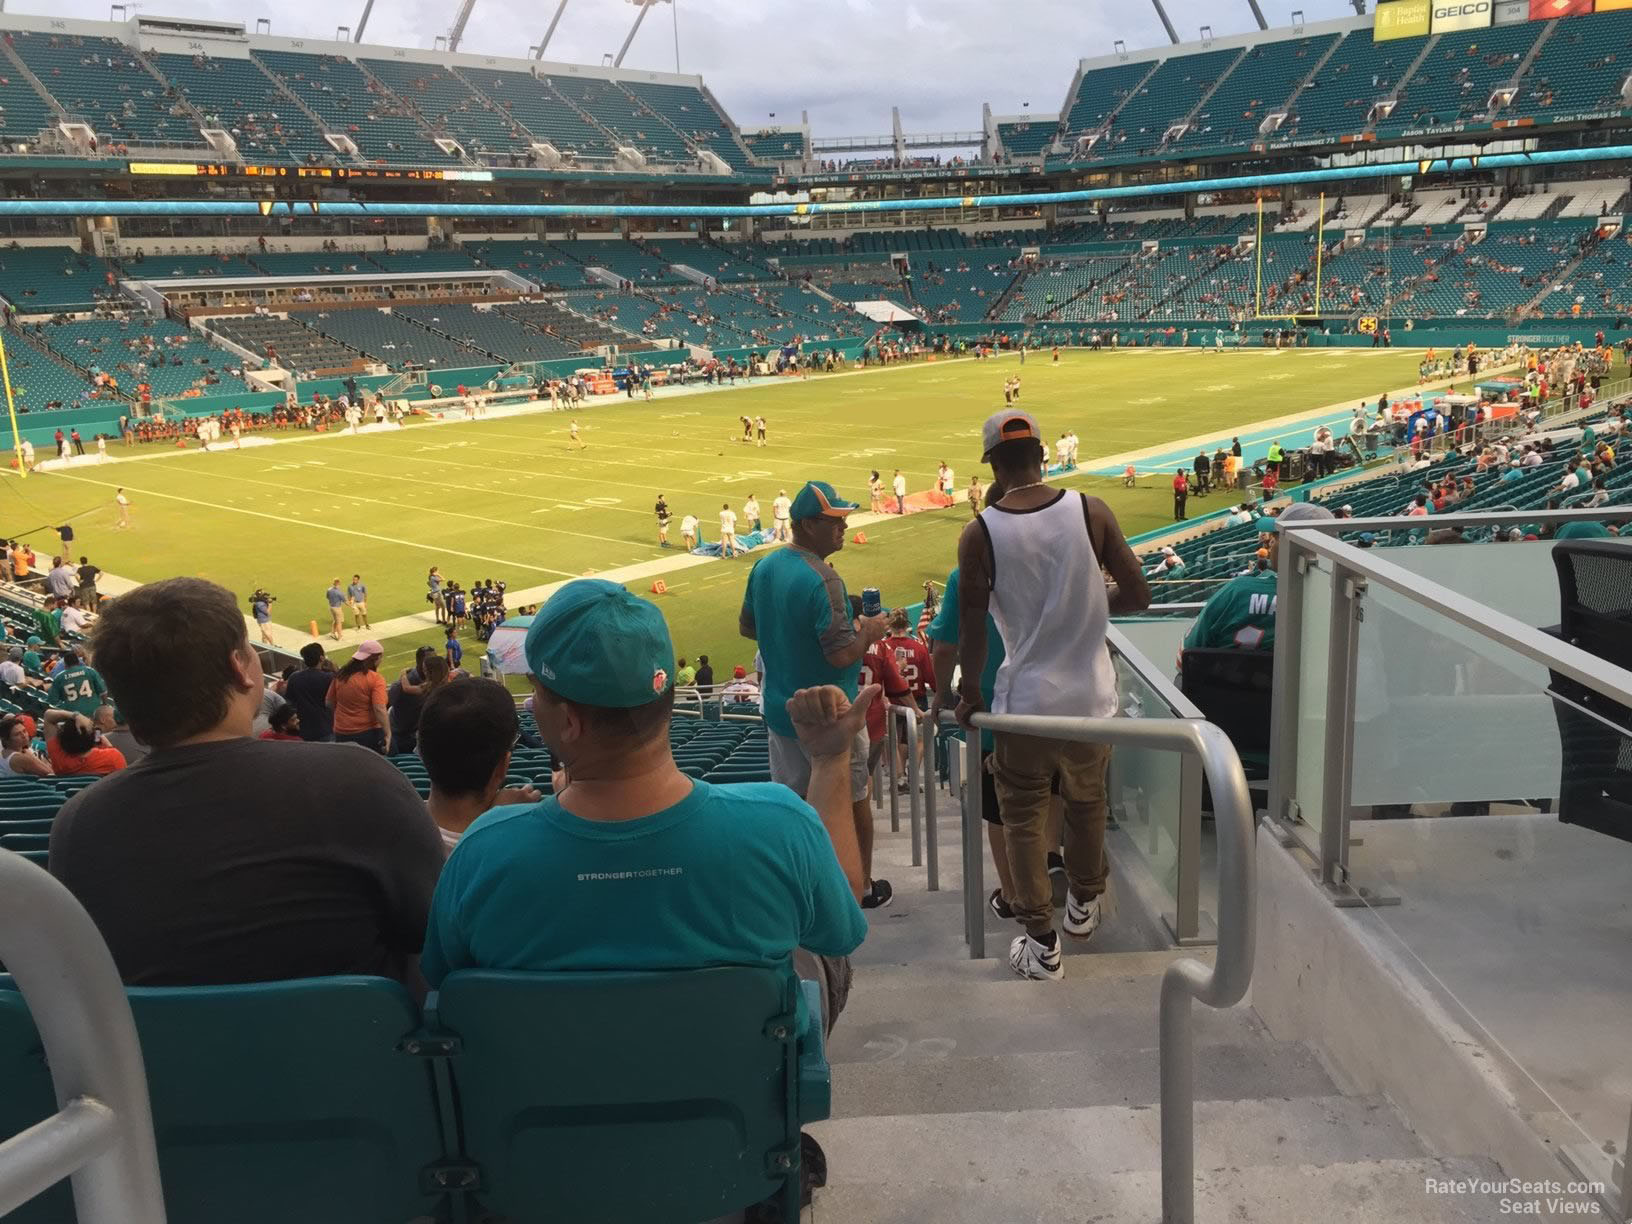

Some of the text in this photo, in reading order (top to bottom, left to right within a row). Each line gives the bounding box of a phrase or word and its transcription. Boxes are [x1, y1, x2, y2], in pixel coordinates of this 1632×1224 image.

[1397, 4, 1427, 19] Baptist
[1434, 2, 1490, 20] GEICO
[1507, 6, 1521, 15] 304
[50, 20, 66, 29] 345
[1396, 13, 1425, 25] Health
[189, 41, 203, 50] 346
[291, 40, 304, 48] 347
[1553, 111, 1621, 123] ZACH THOMAS 54
[1402, 128, 1425, 137] JASON
[1426, 126, 1453, 136] TAYLOR
[1360, 318, 1377, 331] 25
[1354, 605, 1365, 623] 26
[63, 679, 93, 702] 54
